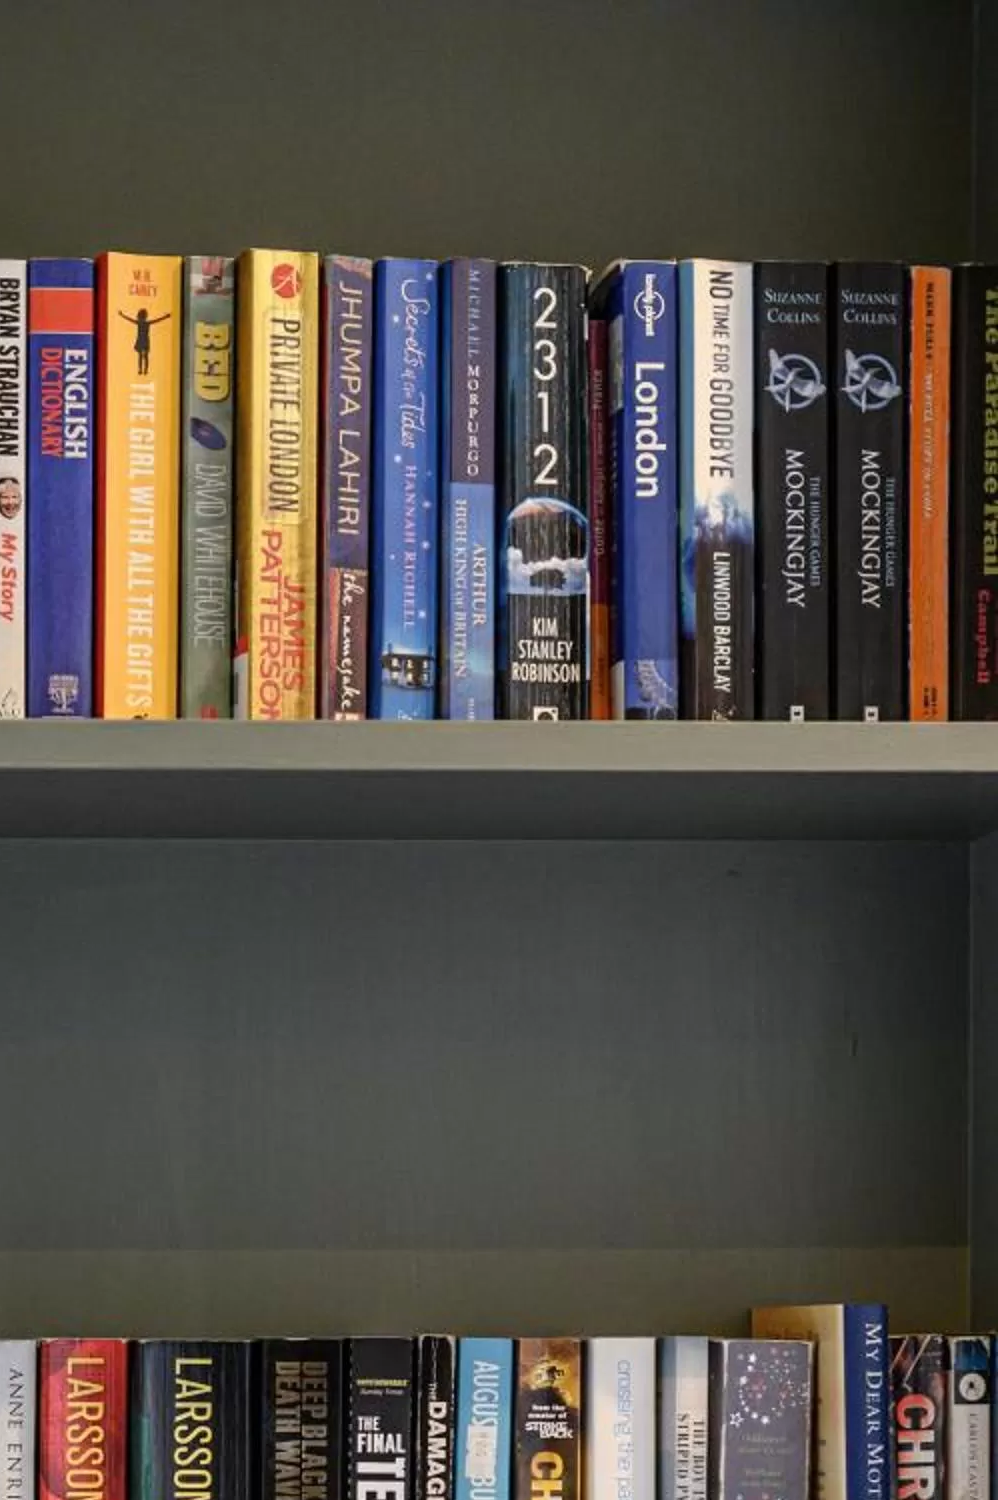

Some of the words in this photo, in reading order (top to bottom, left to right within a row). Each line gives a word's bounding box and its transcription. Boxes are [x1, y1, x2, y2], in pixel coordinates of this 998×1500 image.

[764, 289, 821, 304] SUZANNE
[765, 307, 820, 325] COLLINS
[841, 289, 899, 305] SUZANNE
[842, 307, 898, 325] COLLINS
[269, 318, 302, 411] PRIVATE
[338, 280, 363, 416] JHUMPA
[41, 347, 63, 458] DICTIONARY
[64, 348, 89, 459] ENGLISH
[634, 361, 667, 498] London
[267, 420, 301, 514] LONDON
[338, 429, 362, 536] LAHIRI
[784, 448, 805, 607] MOCKINGJAY
[859, 448, 881, 608] MOCKINGJAY
[712, 551, 731, 622] LINWOOD
[282, 573, 306, 691] JAMES
[518, 639, 574, 660] STANLEY
[532, 617, 559, 637] KIM
[712, 625, 731, 692] BARCLAY
[511, 662, 581, 682] ROBINSON
[5, 1368, 25, 1431] ANNE
[357, 1415, 381, 1432] THE
[356, 1433, 407, 1453] FINAL
